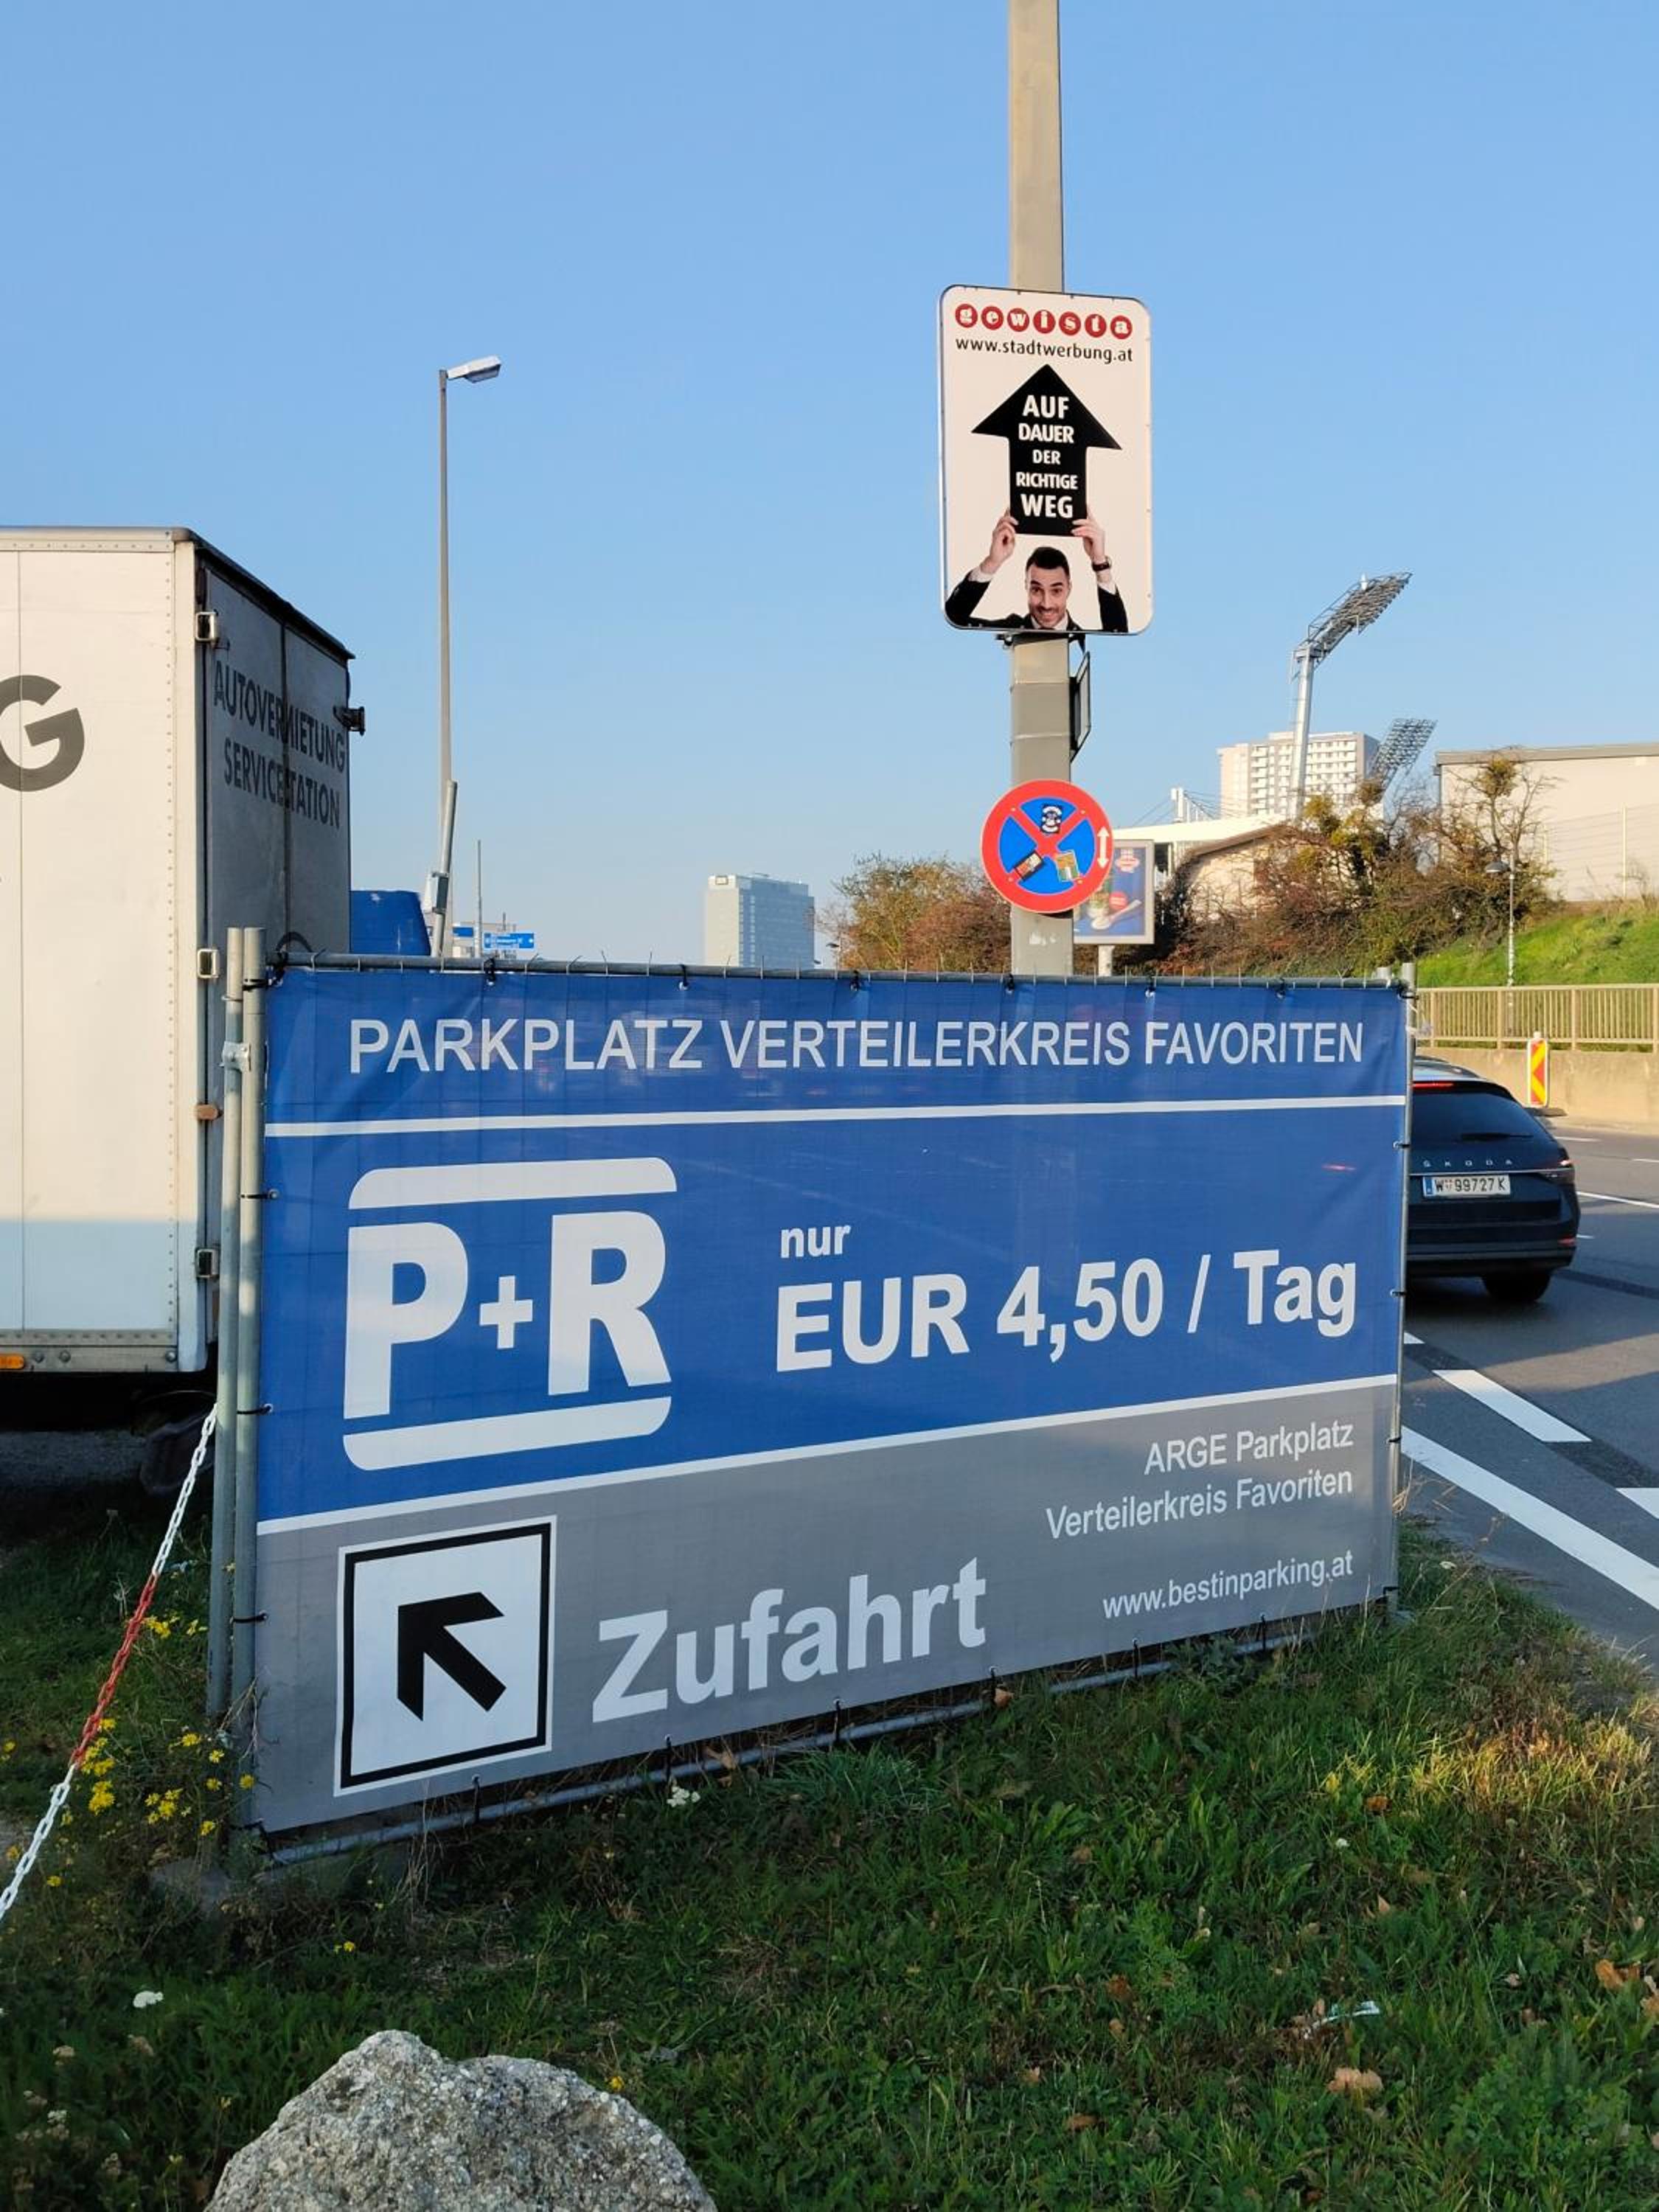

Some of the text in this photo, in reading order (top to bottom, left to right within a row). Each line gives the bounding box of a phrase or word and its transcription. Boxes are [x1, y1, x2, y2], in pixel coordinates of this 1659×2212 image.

[955, 304, 1133, 338] gewista
[956, 338, 1133, 364] www.stadtwerbung.at
[1022, 394, 1070, 419] AUF
[1018, 423, 1074, 444] DAUER
[1032, 450, 1061, 465] DER
[1016, 472, 1078, 490] RICHTIGE
[1020, 494, 1074, 518] WEG
[350, 1018, 1365, 1074] PARKPLATZ VERTEILERKREIS FAVORITEN
[780, 1224, 851, 1259] nur
[343, 1209, 672, 1420] P+R
[776, 1249, 1357, 1372] EUR 4,50 / Tag
[1144, 1420, 1354, 1475] ARGE Parkplatz
[1046, 1469, 1353, 1540] Verteilerkreis Favoriten
[1102, 1549, 1354, 1619] www.bestinparking.at
[592, 1557, 986, 1722] Zufahrt
